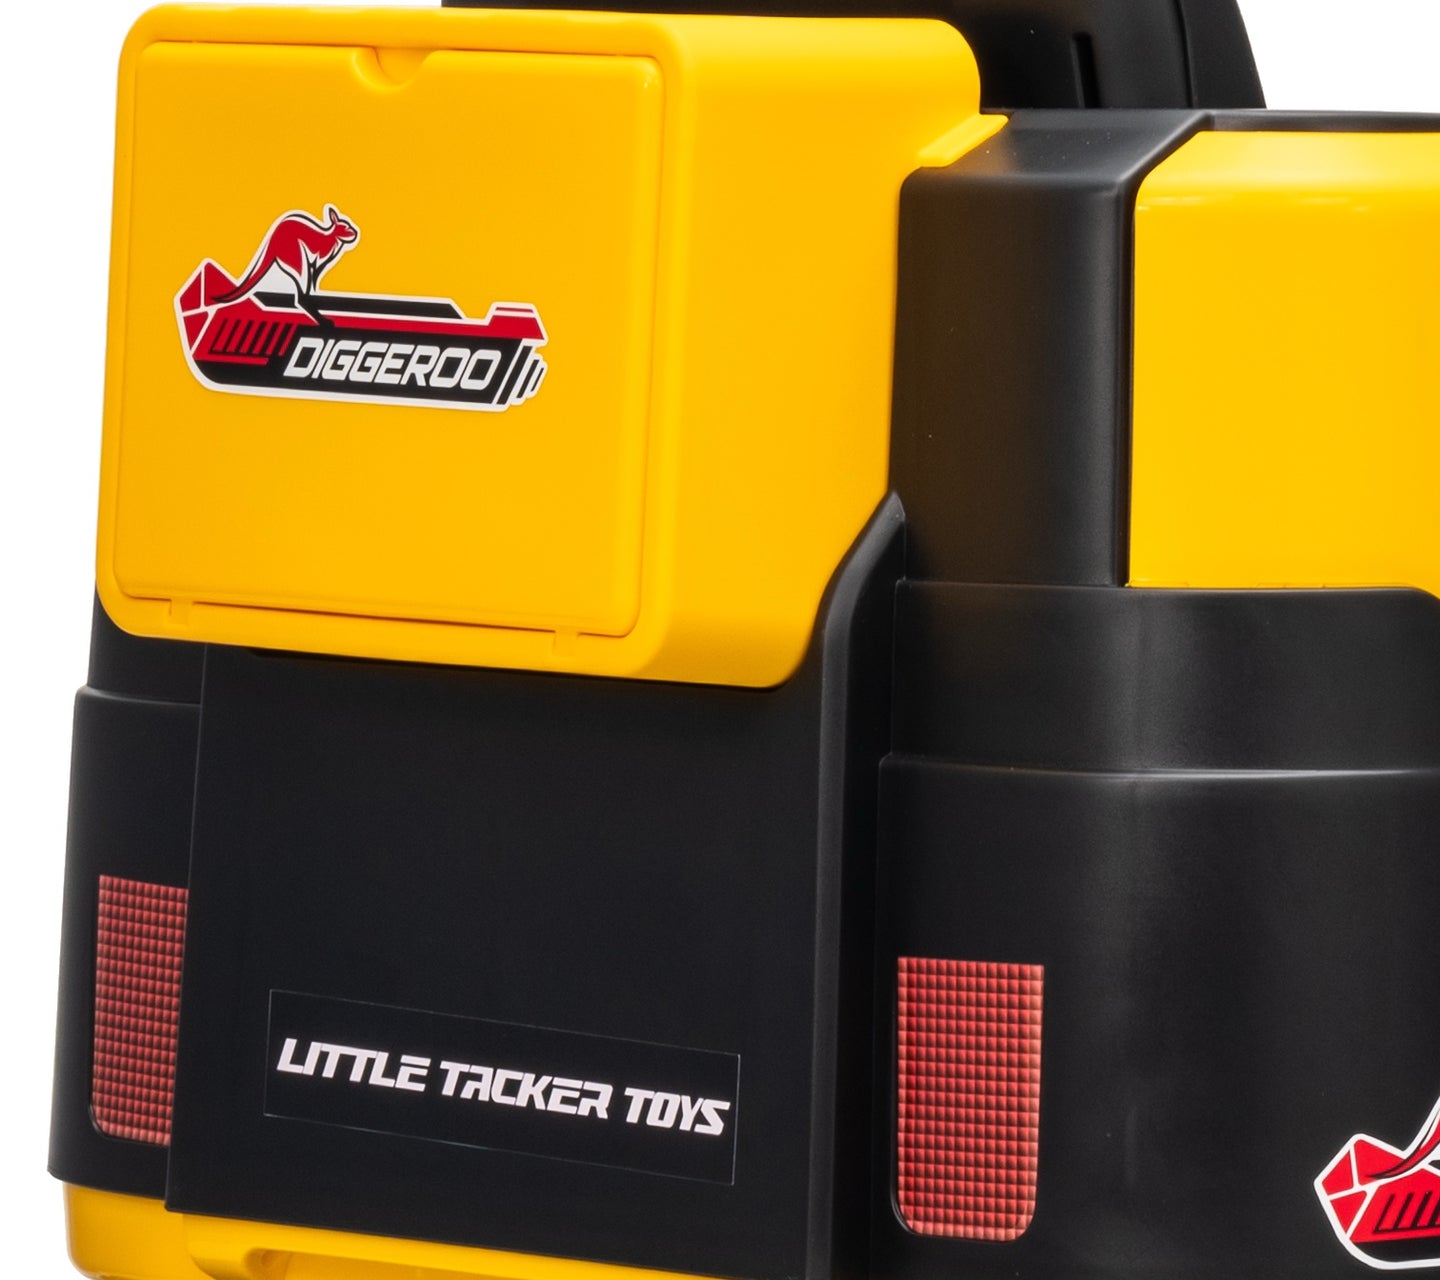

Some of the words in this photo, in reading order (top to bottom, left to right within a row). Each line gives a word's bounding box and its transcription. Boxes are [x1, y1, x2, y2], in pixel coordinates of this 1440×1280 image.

[283, 337, 502, 390] DIGGEROO
[276, 1037, 431, 1092] LITTLE
[440, 1060, 613, 1120] TACKER
[624, 1087, 731, 1136] TOYS
